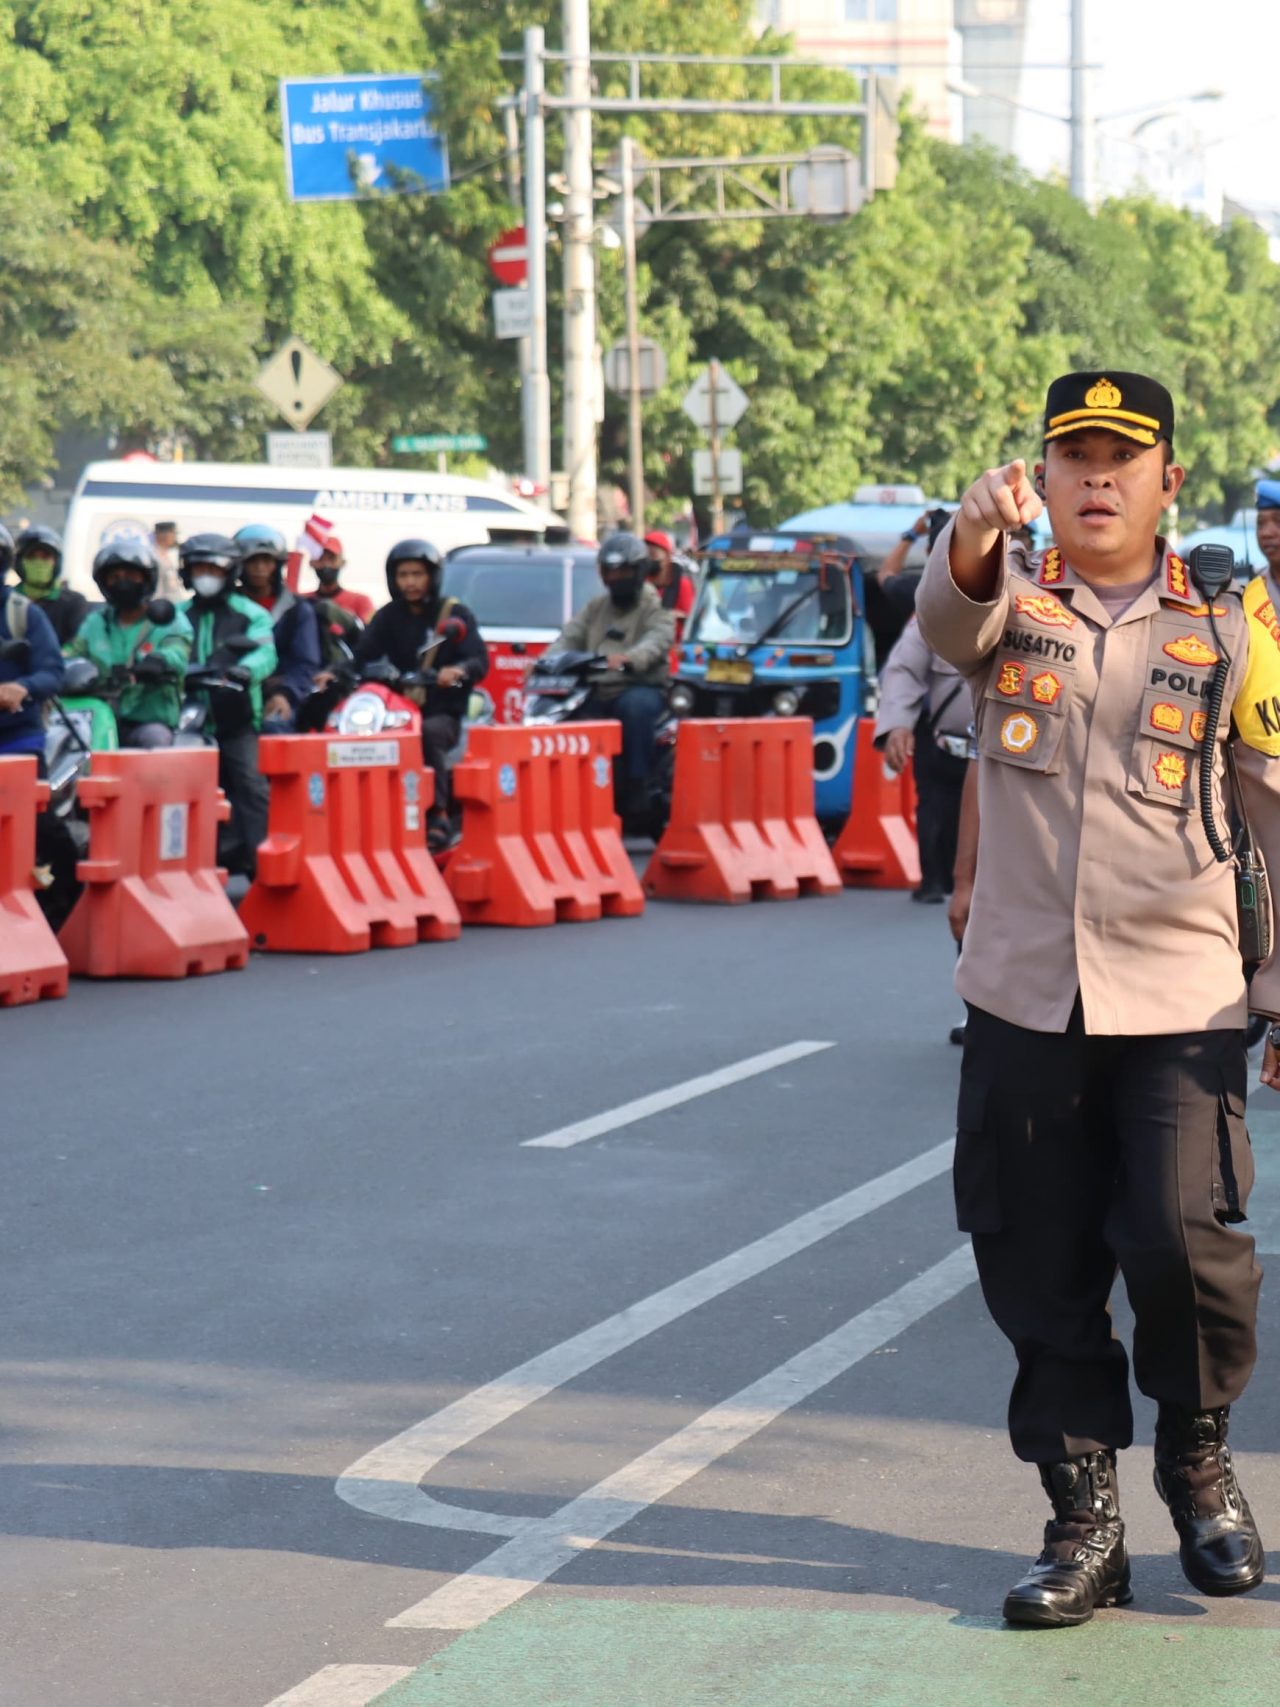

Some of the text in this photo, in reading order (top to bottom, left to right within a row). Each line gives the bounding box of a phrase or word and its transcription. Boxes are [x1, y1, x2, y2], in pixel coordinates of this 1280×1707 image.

[312, 88, 423, 113] Jalur Khusus
[292, 124, 325, 144] Bus
[313, 490, 468, 511] AMBULANS
[1003, 629, 1076, 662] SUSATYO
